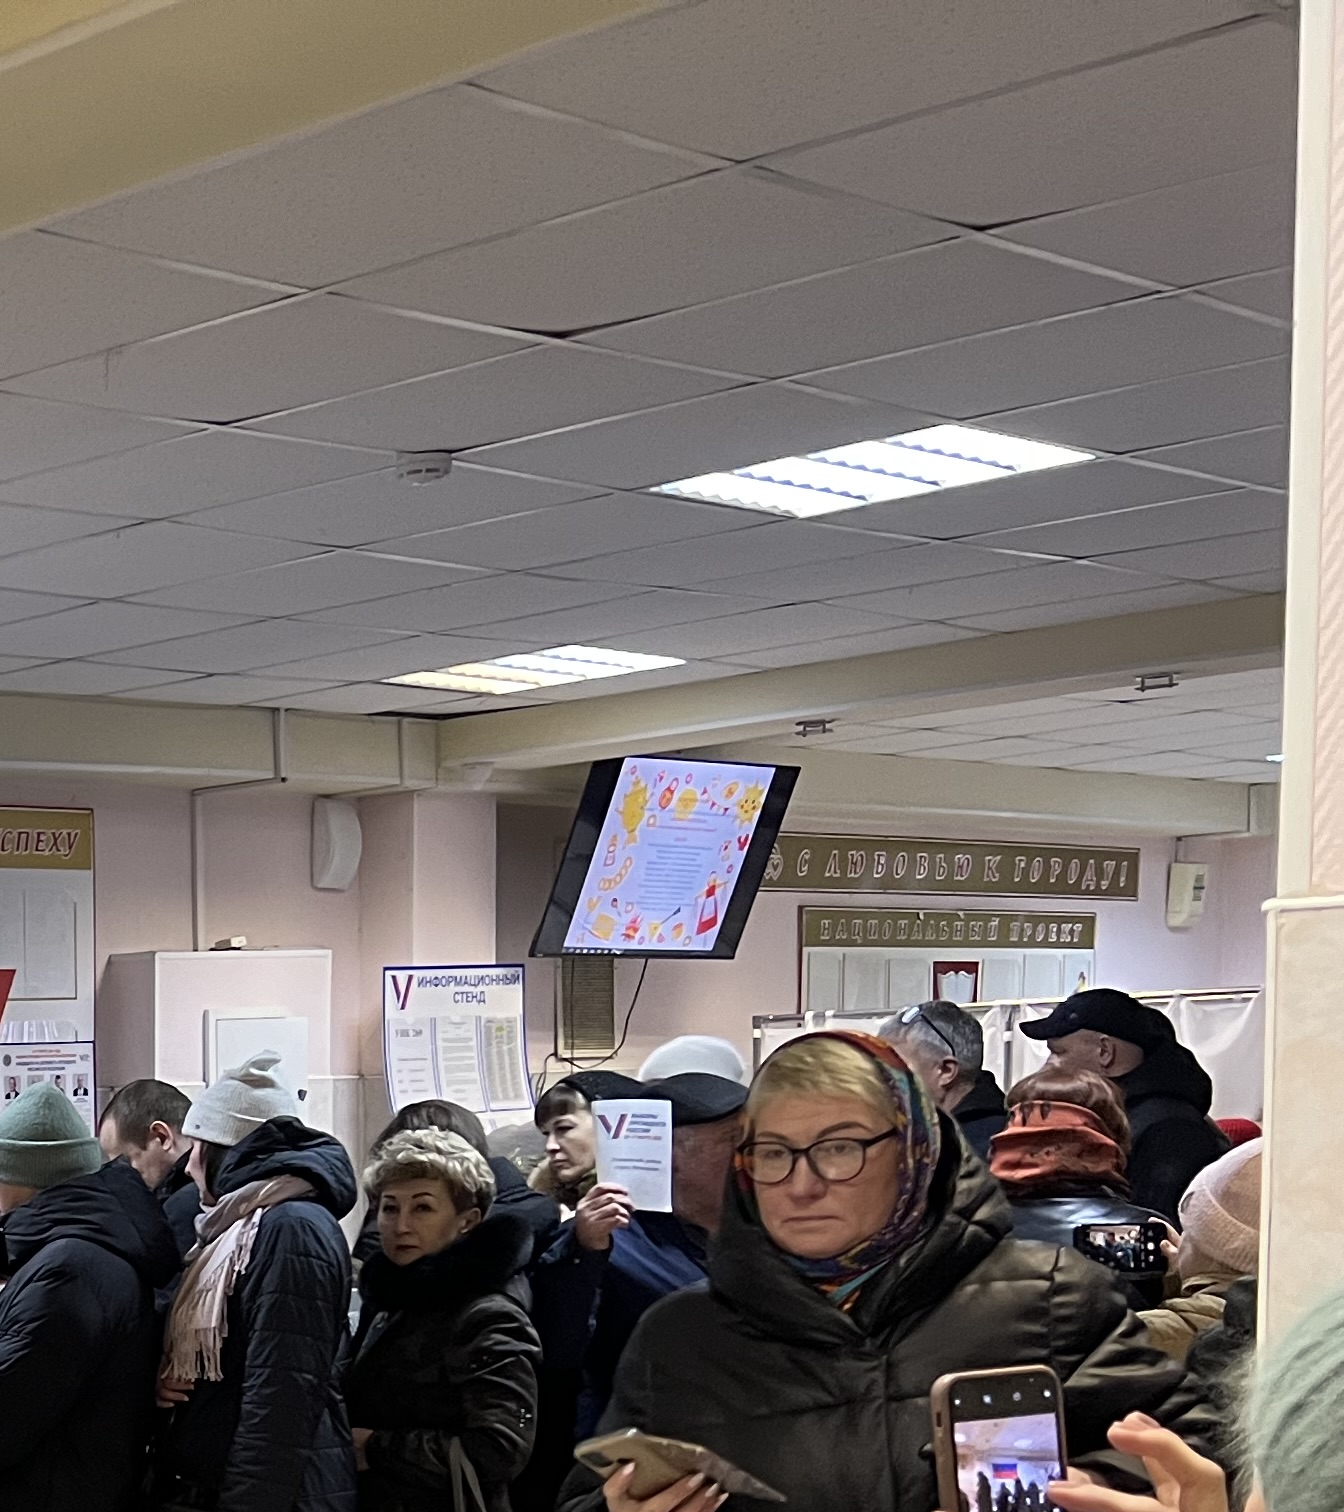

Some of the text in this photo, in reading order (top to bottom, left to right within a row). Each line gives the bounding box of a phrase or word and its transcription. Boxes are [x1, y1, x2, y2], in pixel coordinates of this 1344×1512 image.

[796, 849, 1129, 890] С ЛЮБОВЬЮ К ГОРОДУ!
[820, 917, 1083, 943] НАЦИОНАЛЬНЫЙ ПРОЕКТ
[417, 970, 521, 988] ИНФОРМАЦИОННЫЙ
[453, 990, 486, 1005] СТЕНД
